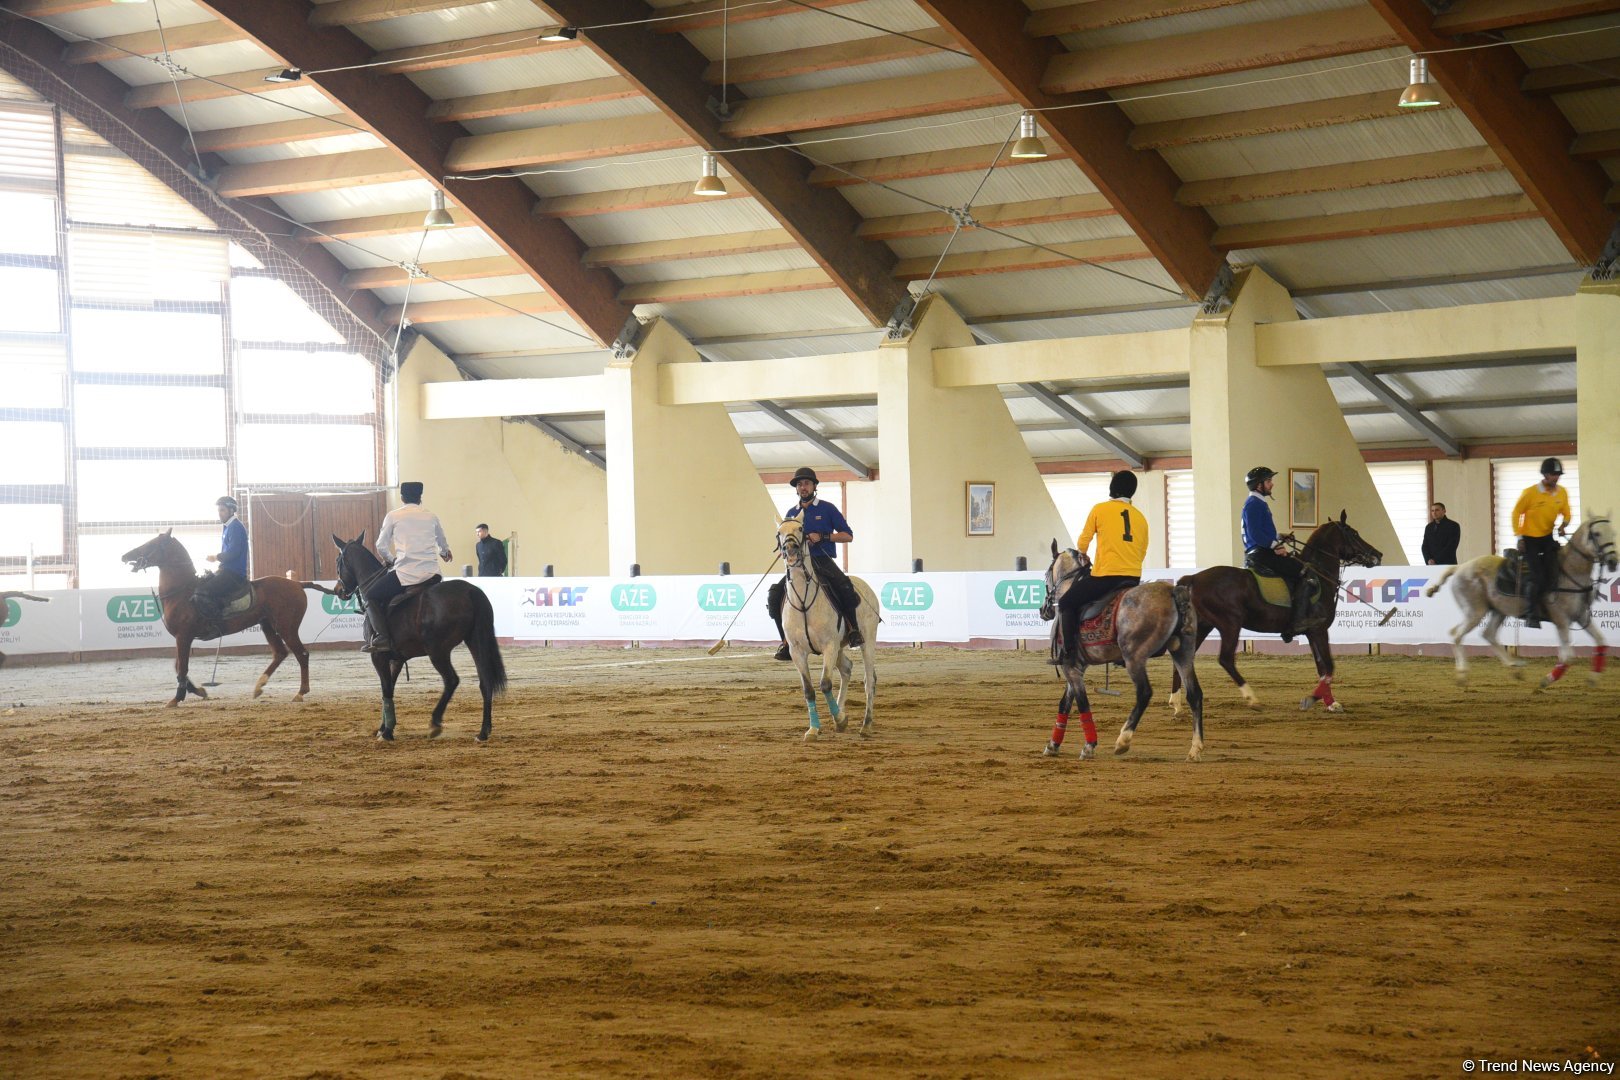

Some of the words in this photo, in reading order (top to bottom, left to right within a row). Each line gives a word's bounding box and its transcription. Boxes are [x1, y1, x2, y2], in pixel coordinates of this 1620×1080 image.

[1121, 509, 1133, 542] 1
[619, 588, 649, 607] AZE
[705, 588, 737, 607] AZE
[890, 586, 925, 606] AZE
[1004, 584, 1040, 605] AZE
[117, 599, 155, 619] AZE
[1335, 610, 1372, 618] ƏRBAYCAN
